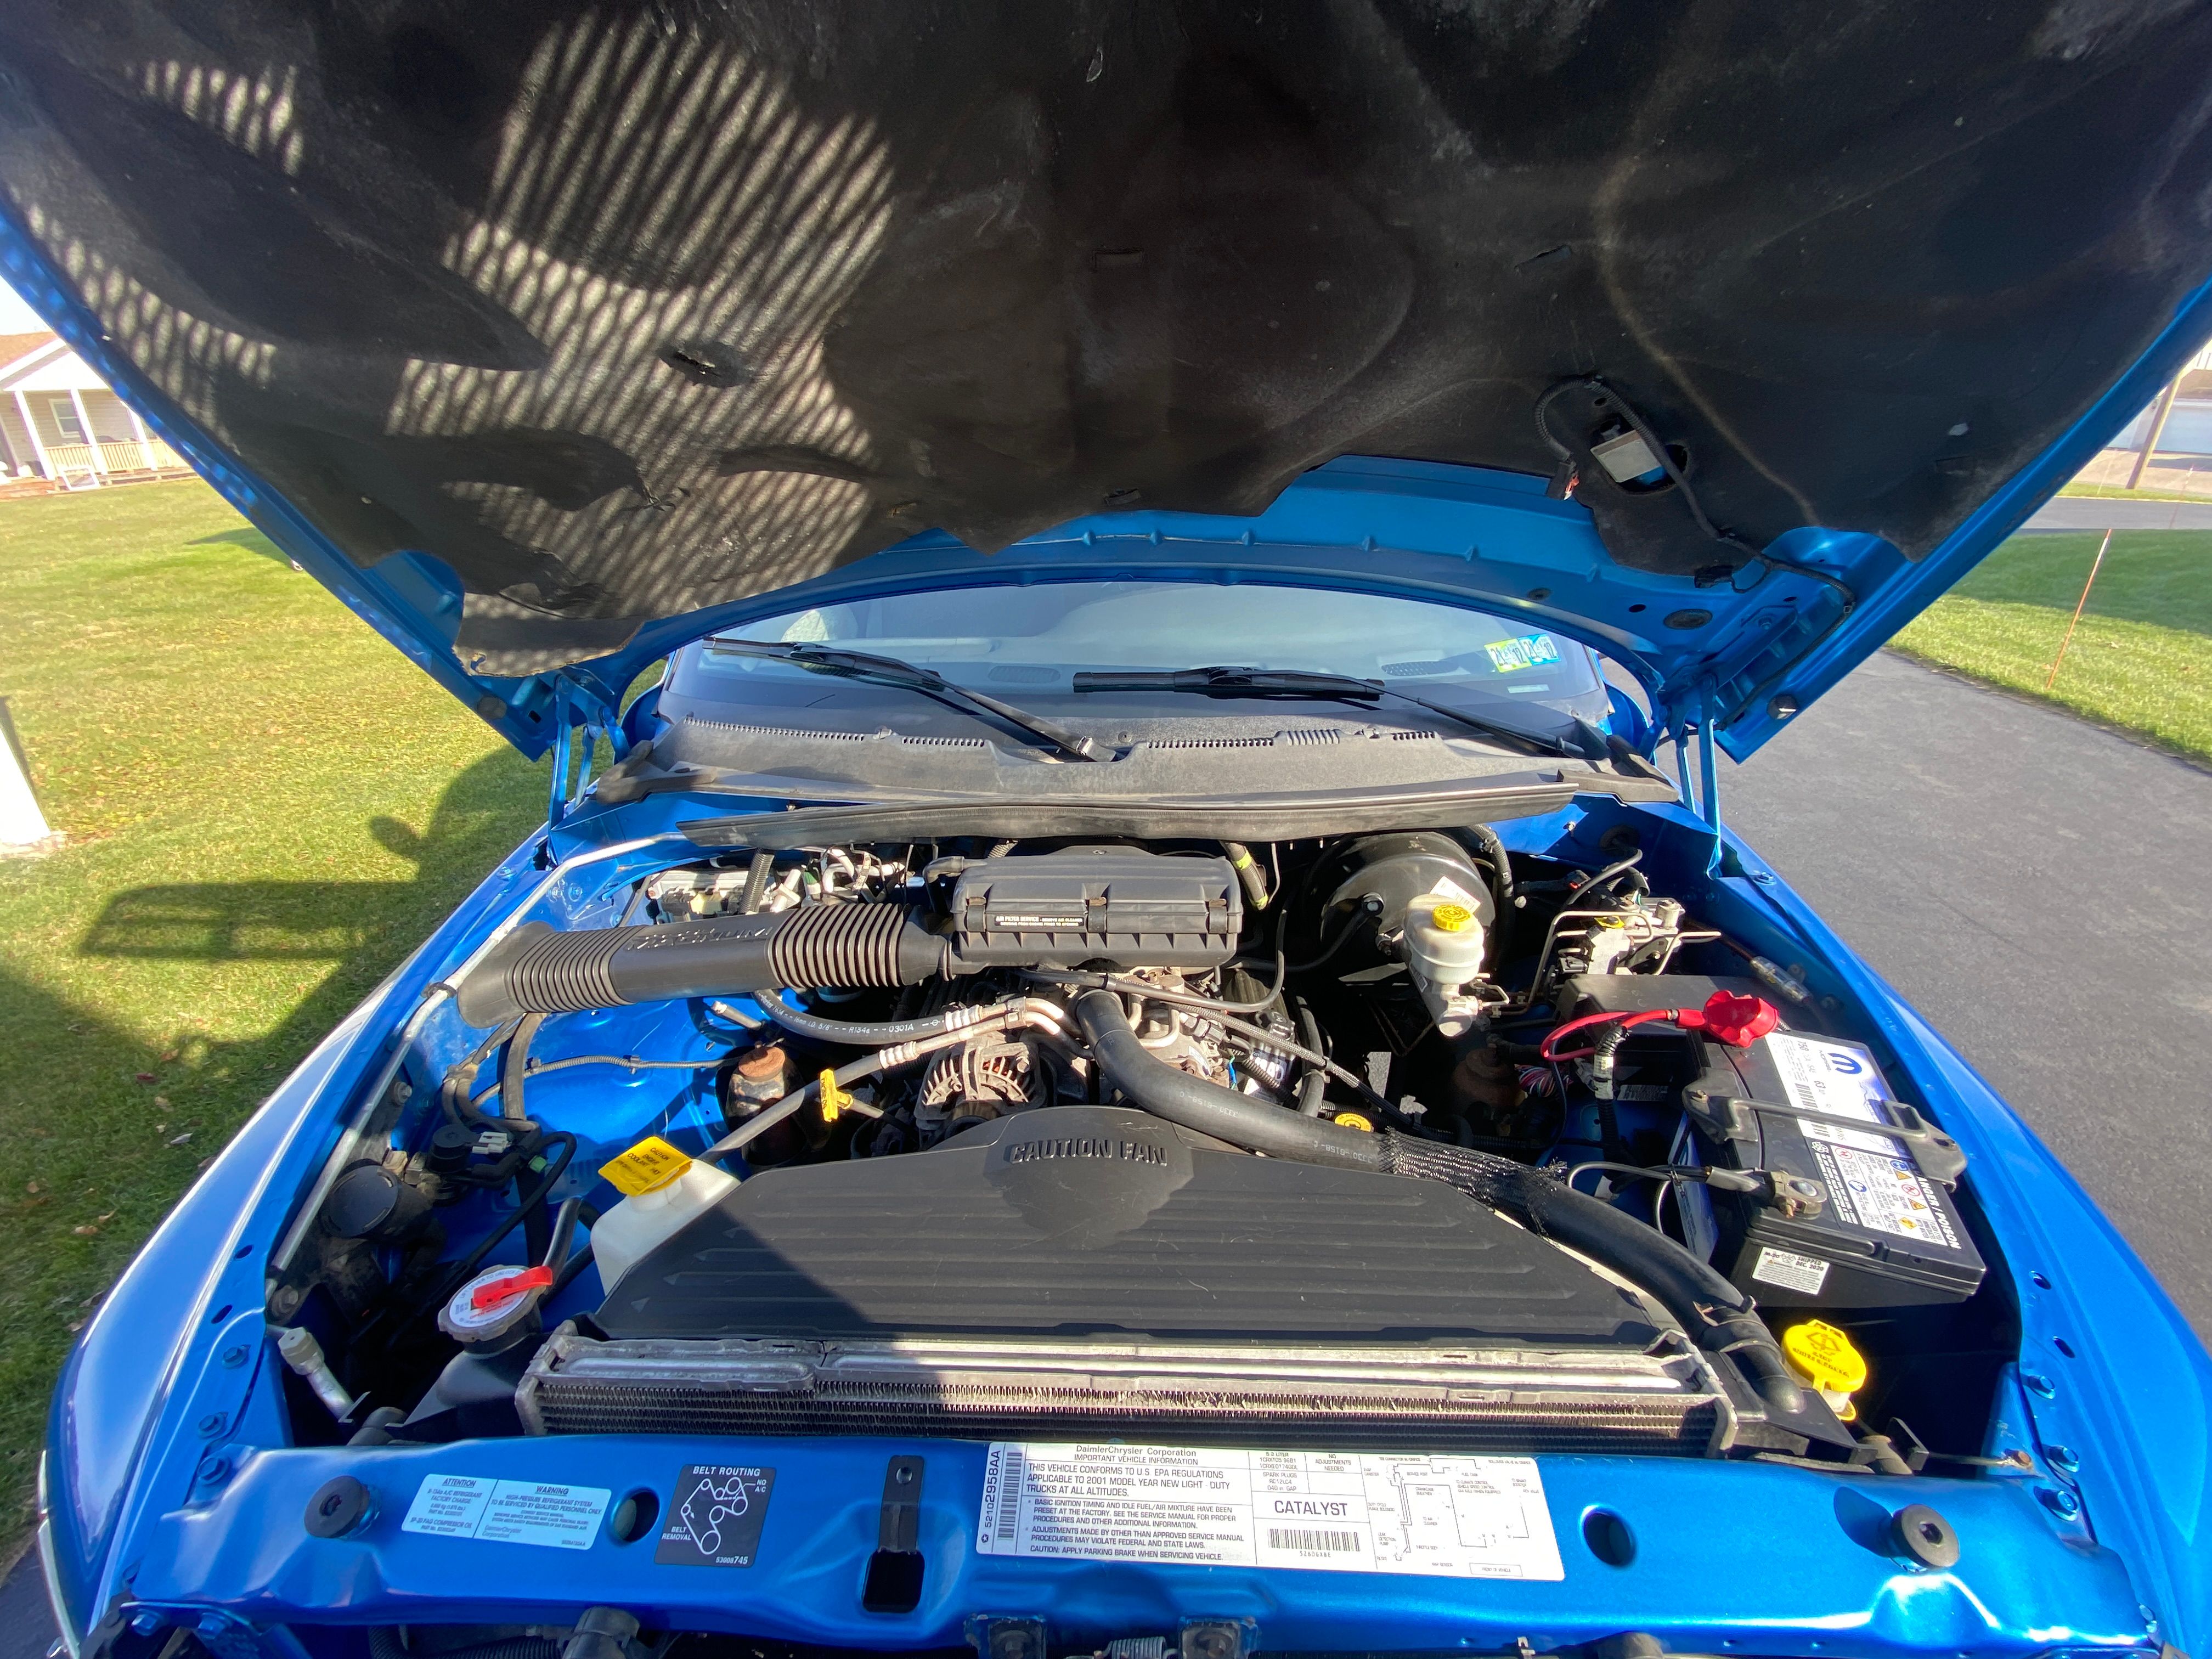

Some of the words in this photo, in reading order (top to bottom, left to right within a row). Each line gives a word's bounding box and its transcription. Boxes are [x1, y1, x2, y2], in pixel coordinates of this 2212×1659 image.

[889, 1023, 914, 1032] 0301A
[1010, 1138, 1113, 1164] CAUTION
[1121, 1143, 1168, 1167] FAN
[1917, 1176, 1940, 1206] ANGER
[1935, 1212, 1962, 1250] POISON
[1797, 1256, 1821, 1265] SHIPPED
[1076, 1445, 1142, 1454] DaimlerChrysler
[1147, 1448, 1196, 1456] Corporation
[692, 1466, 716, 1475] BELT
[719, 1467, 760, 1476] ROUTING
[1028, 1463, 1045, 1472] THIS
[1047, 1464, 1077, 1472] VEHICLE
[1080, 1465, 1122, 1474] CONFORMS
[1172, 1469, 1223, 1478] REGULATIONS
[443, 1478, 477, 1486] ATTENTION
[1027, 1474, 1072, 1483] APPLICABLE
[536, 1486, 569, 1494] WARNING
[1026, 1484, 1057, 1493] TRUCKS
[1086, 1487, 1128, 1496] ALTITUDES.
[1274, 1500, 1347, 1515] CATALYST
